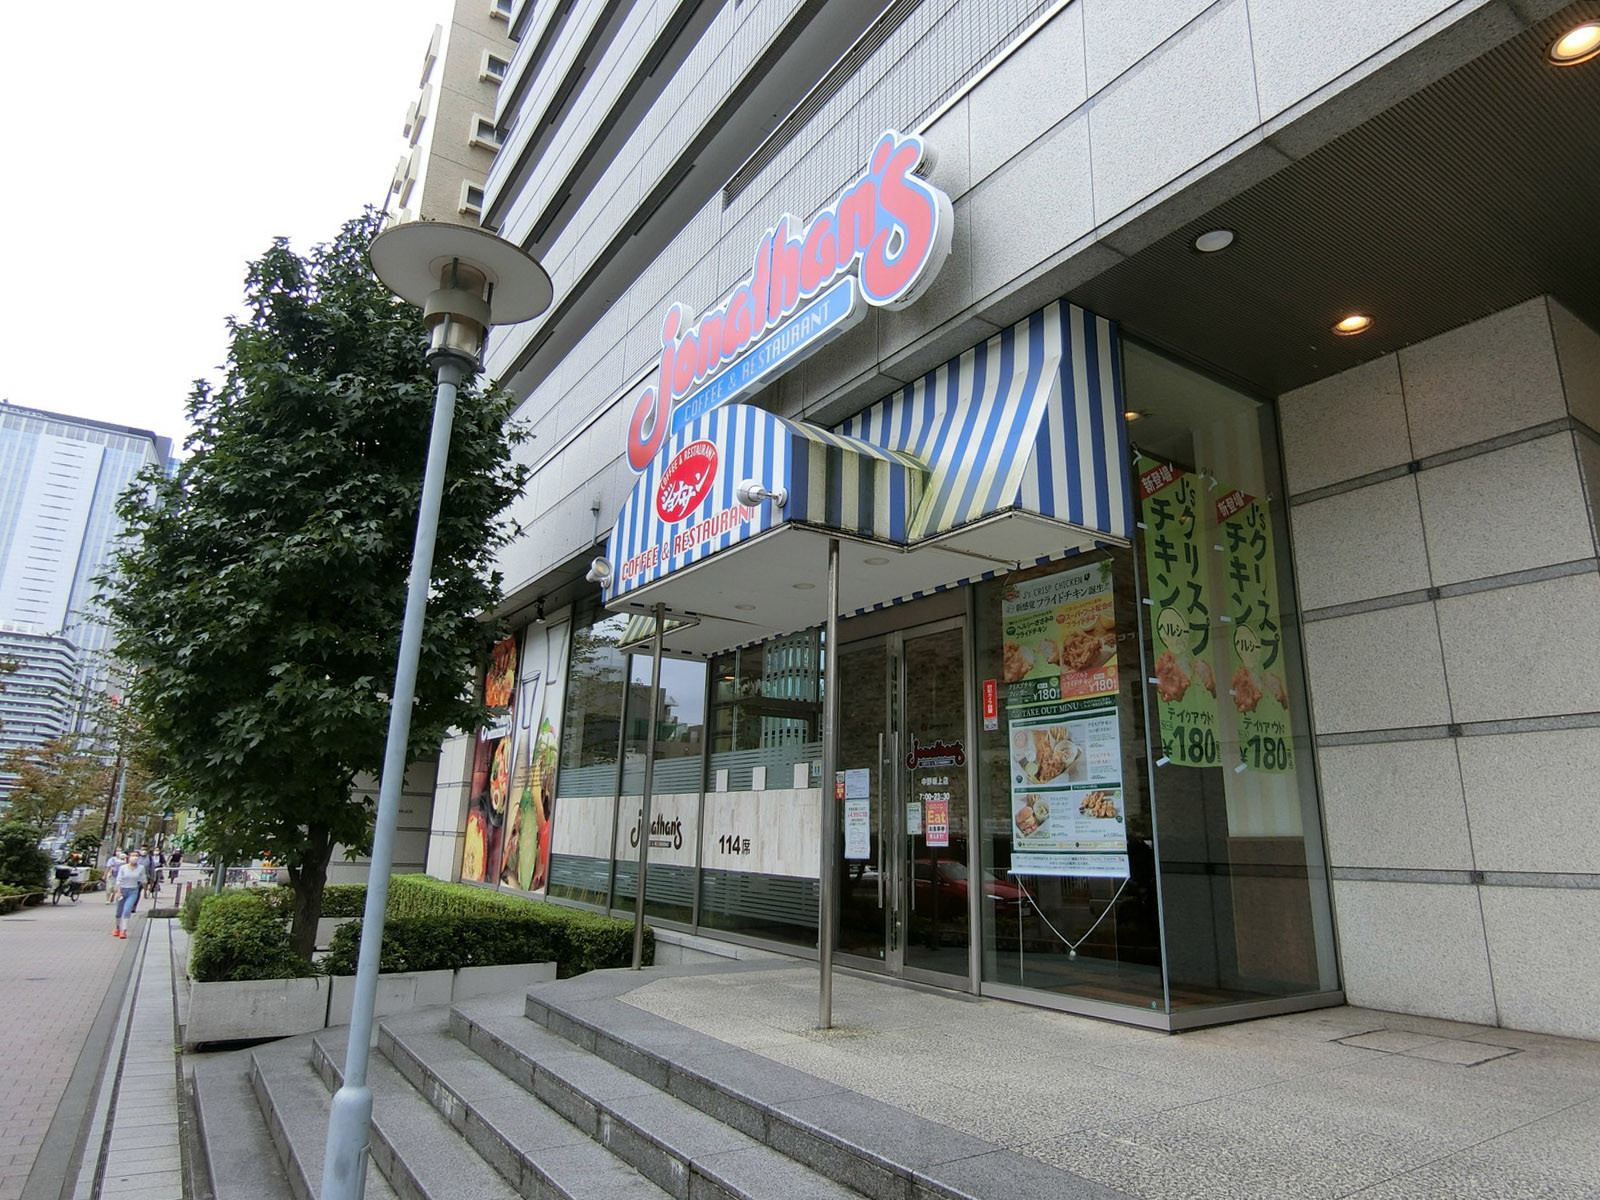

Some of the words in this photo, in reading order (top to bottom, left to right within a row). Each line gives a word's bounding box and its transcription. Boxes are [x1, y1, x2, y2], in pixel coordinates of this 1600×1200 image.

[684, 380, 723, 422] COFFEE
[727, 372, 738, 389] &
[742, 302, 831, 379] RESTAURANT
[660, 458, 679, 490] COFFEE
[684, 443, 717, 462] RESTAURANT
[621, 546, 659, 582] COFFEE
[661, 541, 671, 560] &
[1150, 498, 1181, 608] チキン
[1034, 583, 1053, 597] CRISP
[1054, 576, 1083, 591] CHICKEN
[1226, 522, 1252, 625] チキン
[1158, 623, 1190, 638] ヘルシー
[1021, 707, 1040, 717] TAKE
[1040, 704, 1057, 715] OUT
[1059, 701, 1080, 713] MENU
[1033, 688, 1057, 701] ¥180
[1167, 707, 1214, 725] テイクアウト
[1243, 718, 1285, 736] テイクアウト
[1162, 726, 1216, 764] ¥180
[1239, 735, 1288, 771] ¥180
[630, 808, 683, 850] jathan's
[927, 809, 947, 824] Eat
